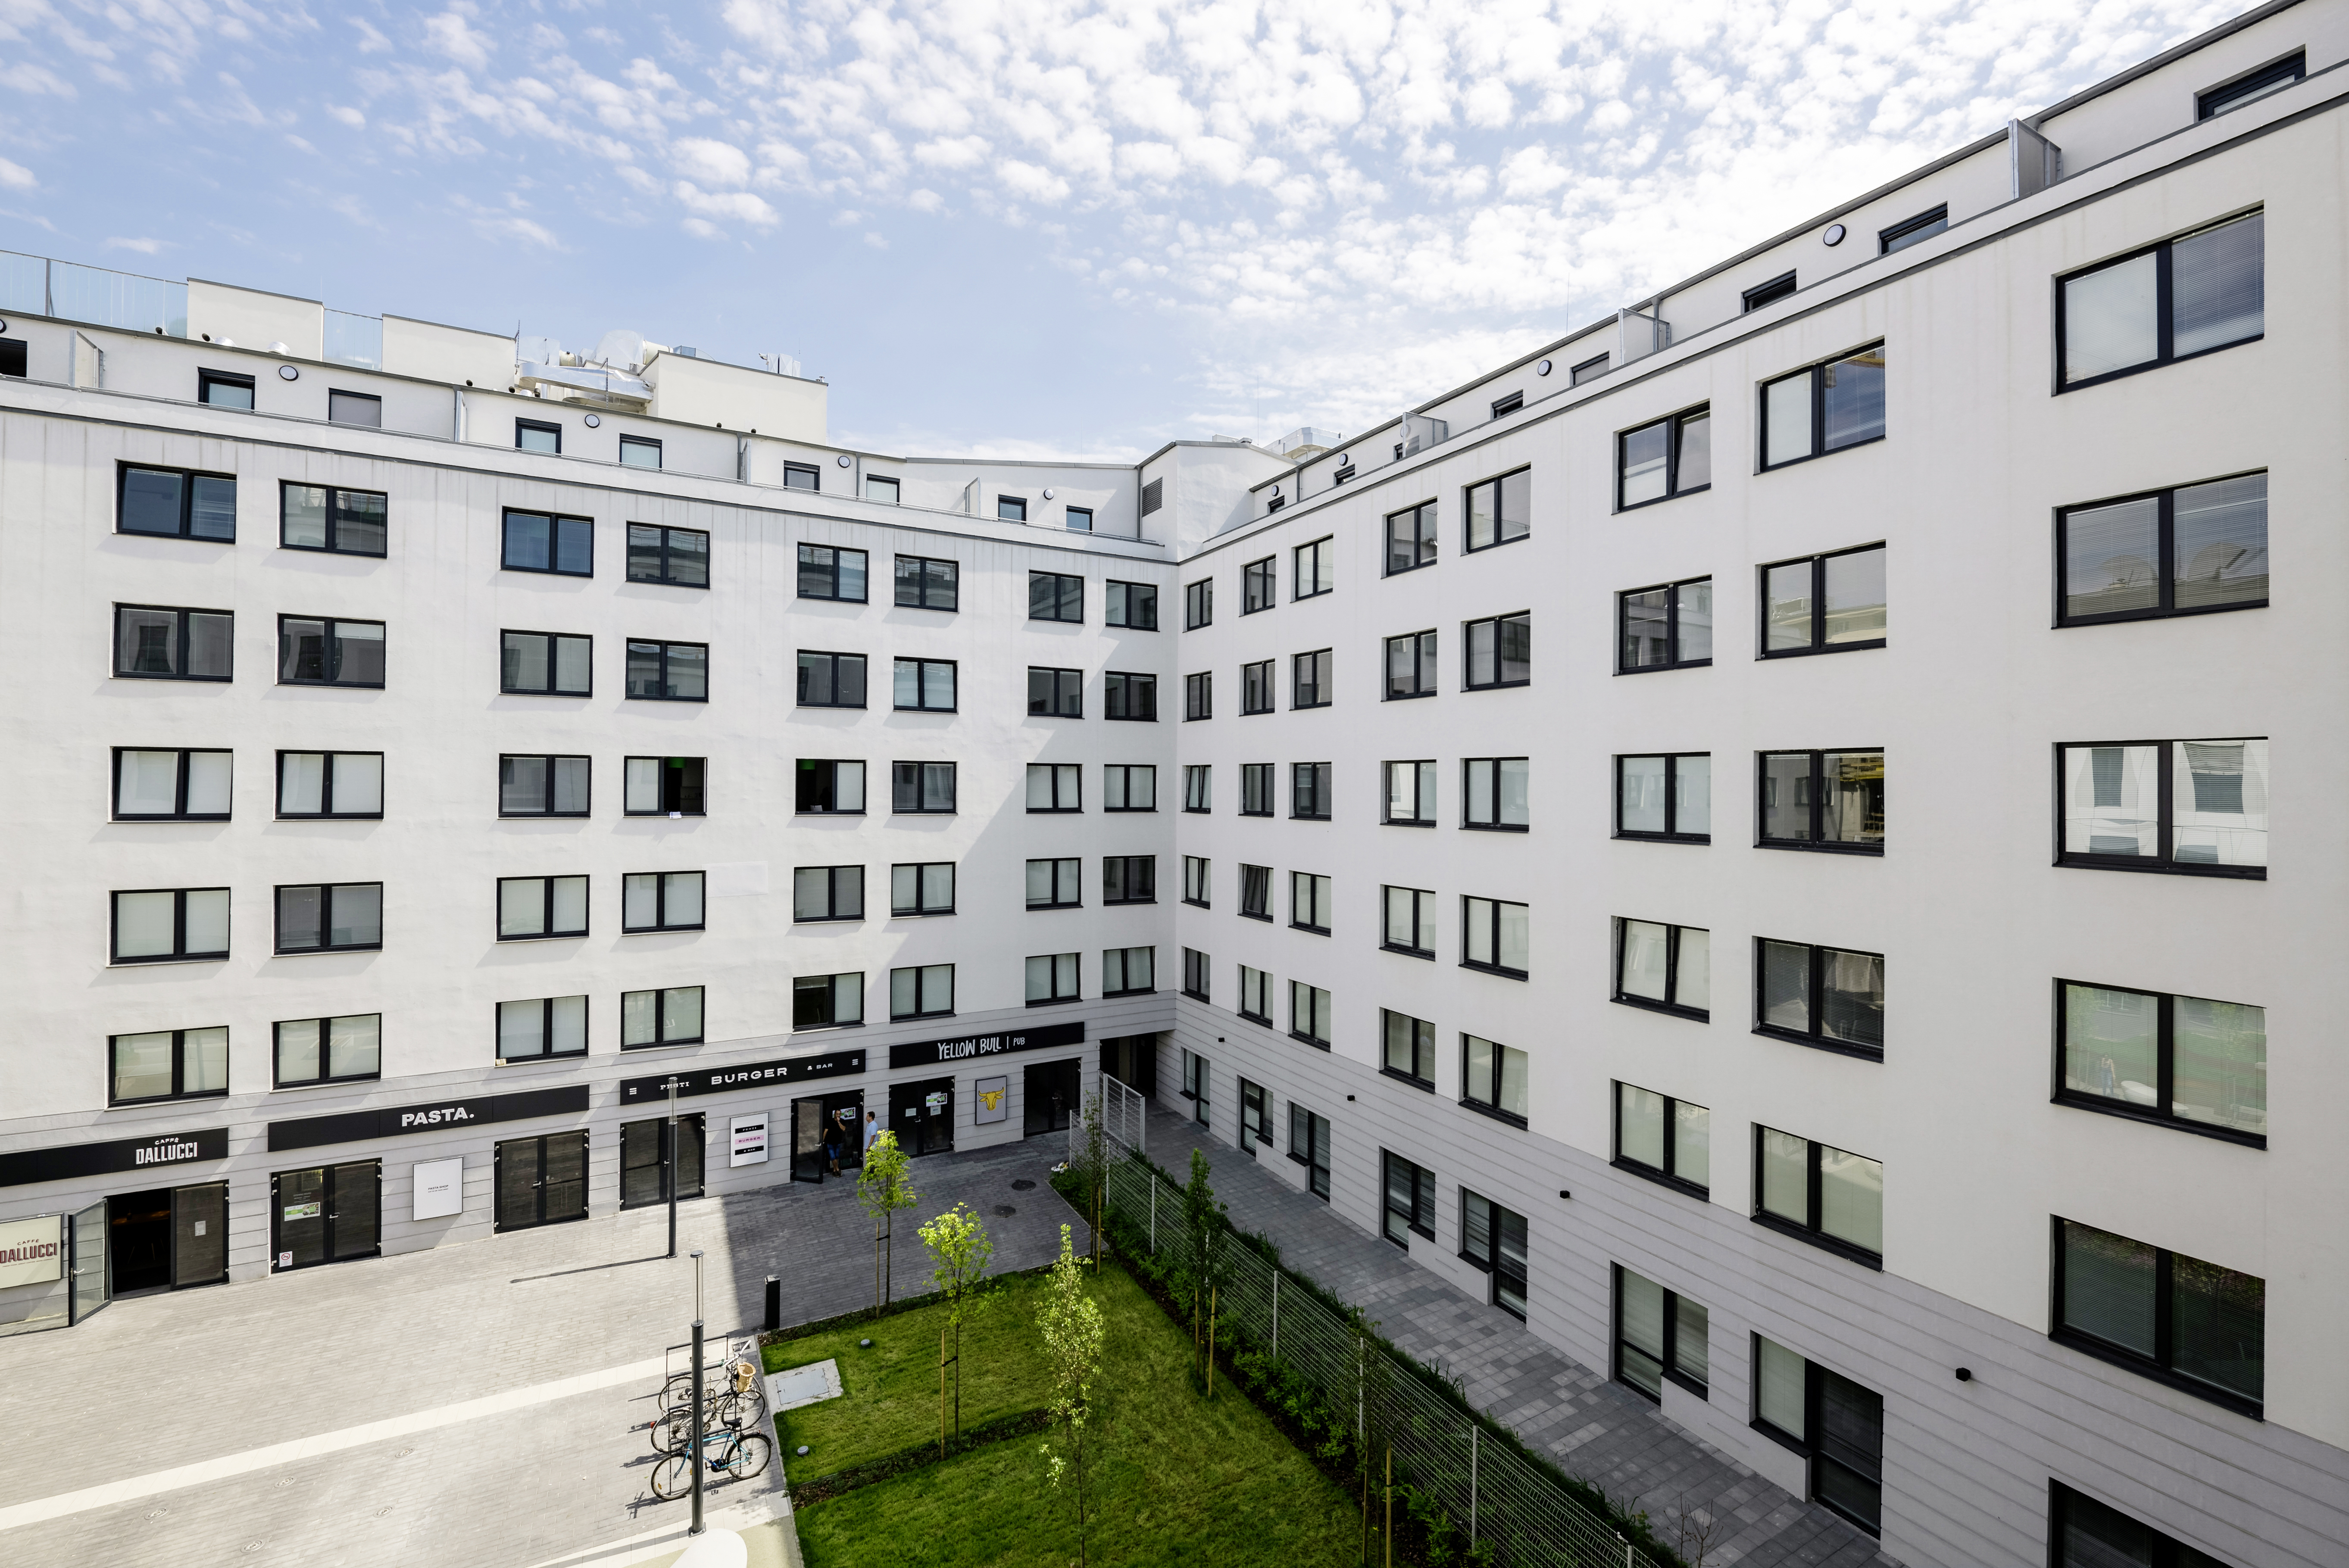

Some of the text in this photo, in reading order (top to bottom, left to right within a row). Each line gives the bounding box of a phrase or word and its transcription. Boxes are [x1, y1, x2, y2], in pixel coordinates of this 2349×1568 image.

[938, 1037, 1025, 1060] YELLOW BULL PUB
[711, 1067, 787, 1085] BURGER
[402, 1107, 474, 1127] PASTA.
[136, 1142, 197, 1164] DALLUCCI
[0, 1242, 57, 1264] DALLUCCI
